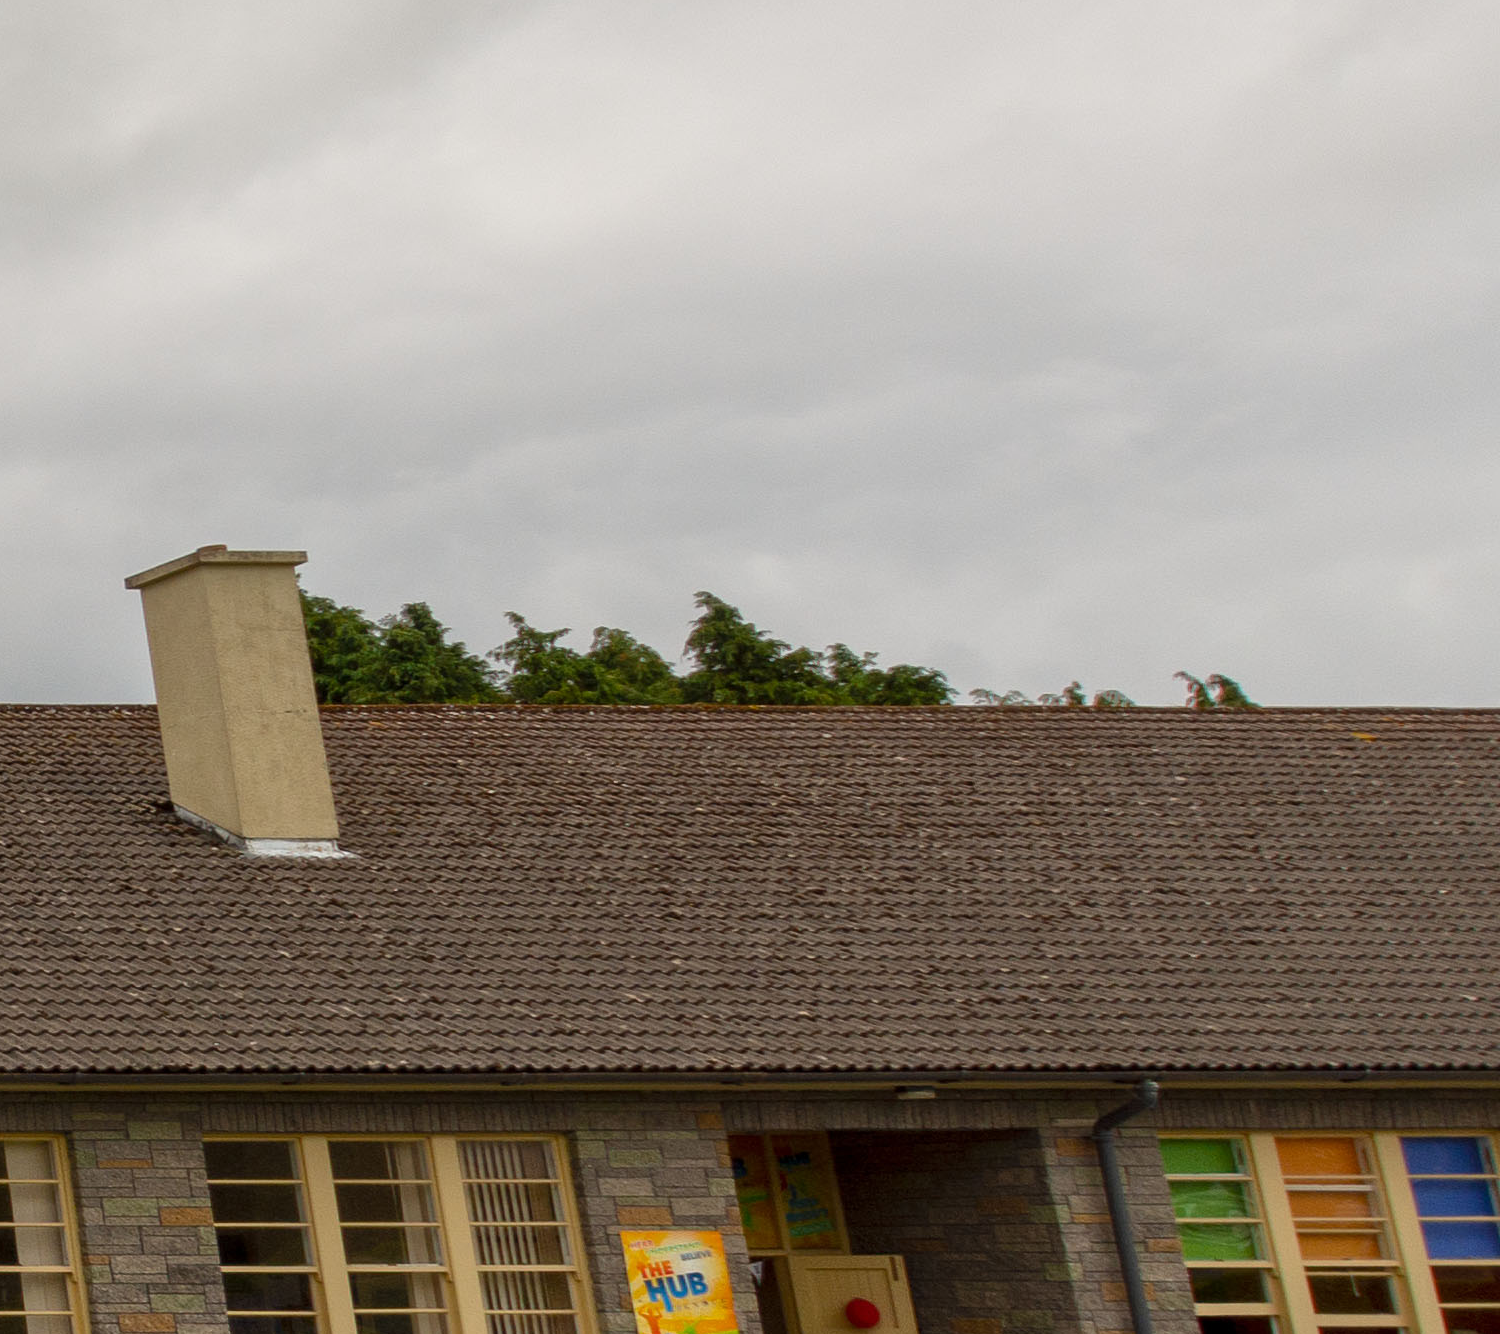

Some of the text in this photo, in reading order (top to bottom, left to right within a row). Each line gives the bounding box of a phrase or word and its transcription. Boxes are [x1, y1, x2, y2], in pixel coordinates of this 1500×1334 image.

[680, 1250, 712, 1261] BELIEVE
[636, 1260, 674, 1279] THE
[644, 1272, 709, 1313] HUB
